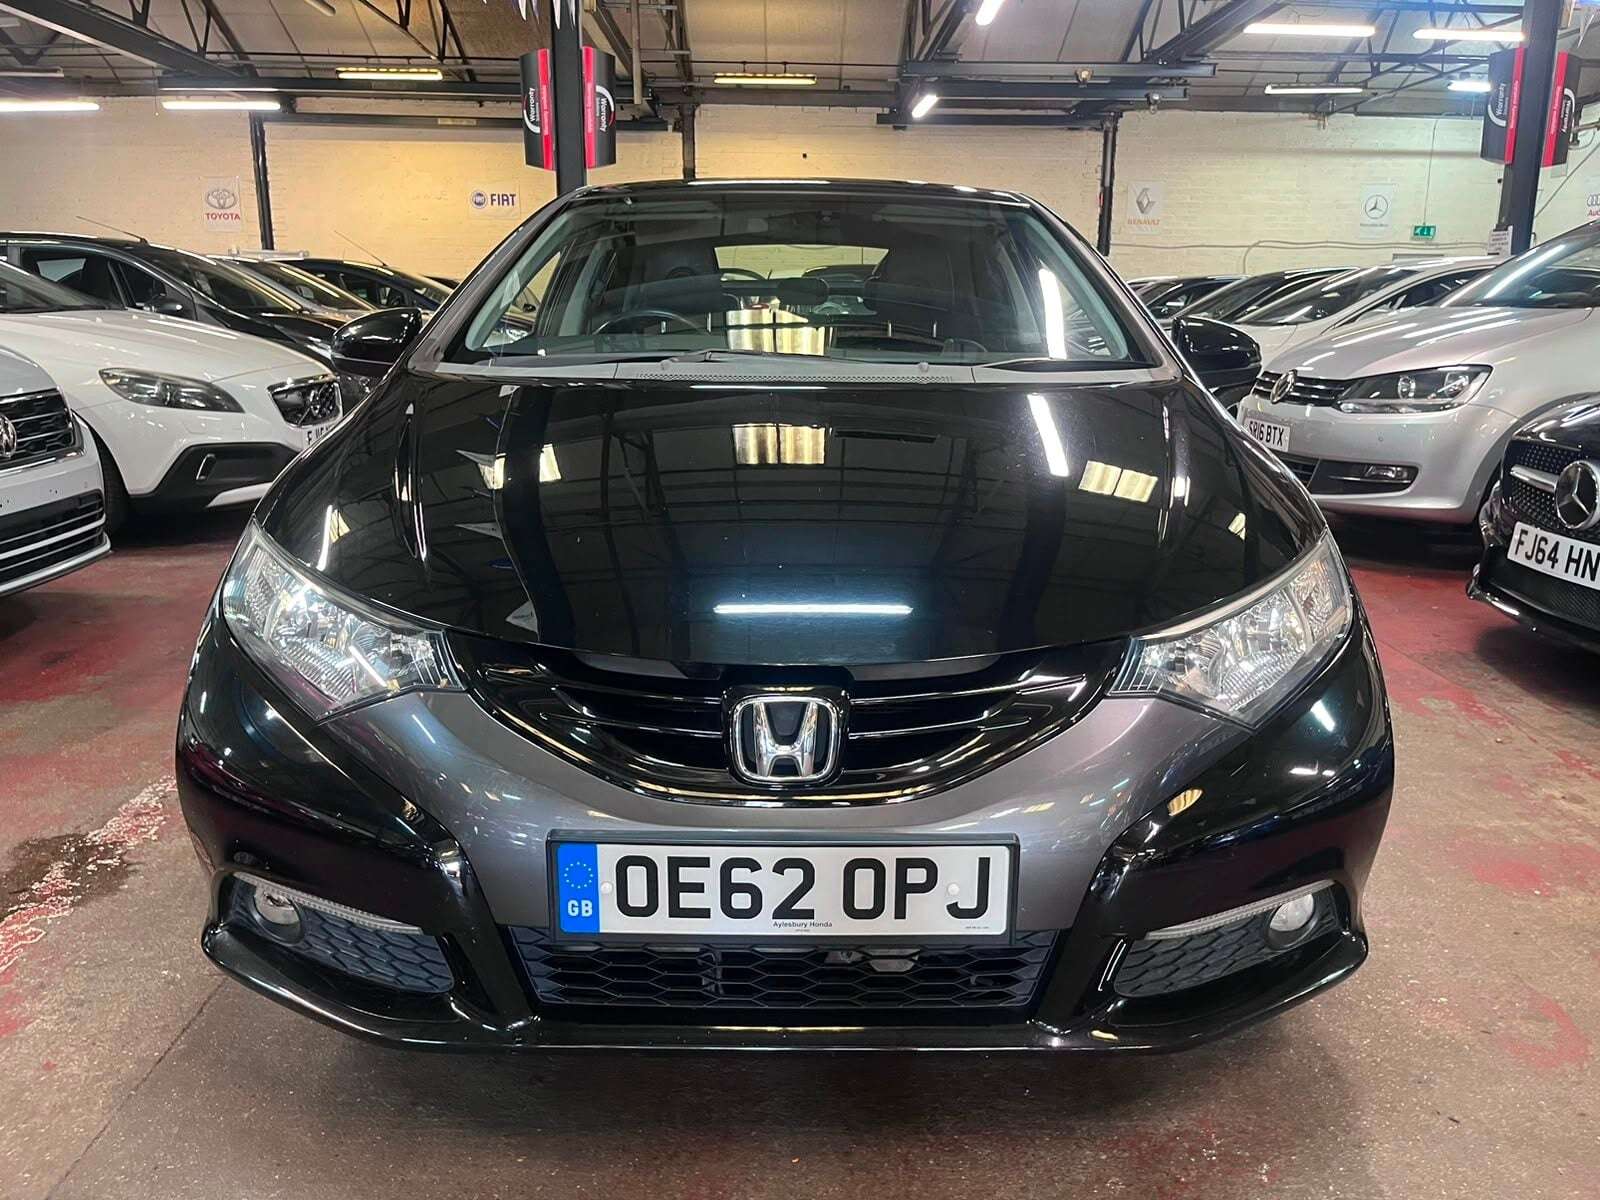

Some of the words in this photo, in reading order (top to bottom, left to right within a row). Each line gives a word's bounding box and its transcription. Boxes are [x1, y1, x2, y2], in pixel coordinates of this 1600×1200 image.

[490, 193, 516, 206] FIAT
[1266, 425, 1285, 447] BTX
[1514, 528, 1559, 569] FJ64
[616, 855, 816, 919] OE62
[843, 857, 990, 919] OPJ
[568, 899, 593, 917] GB
